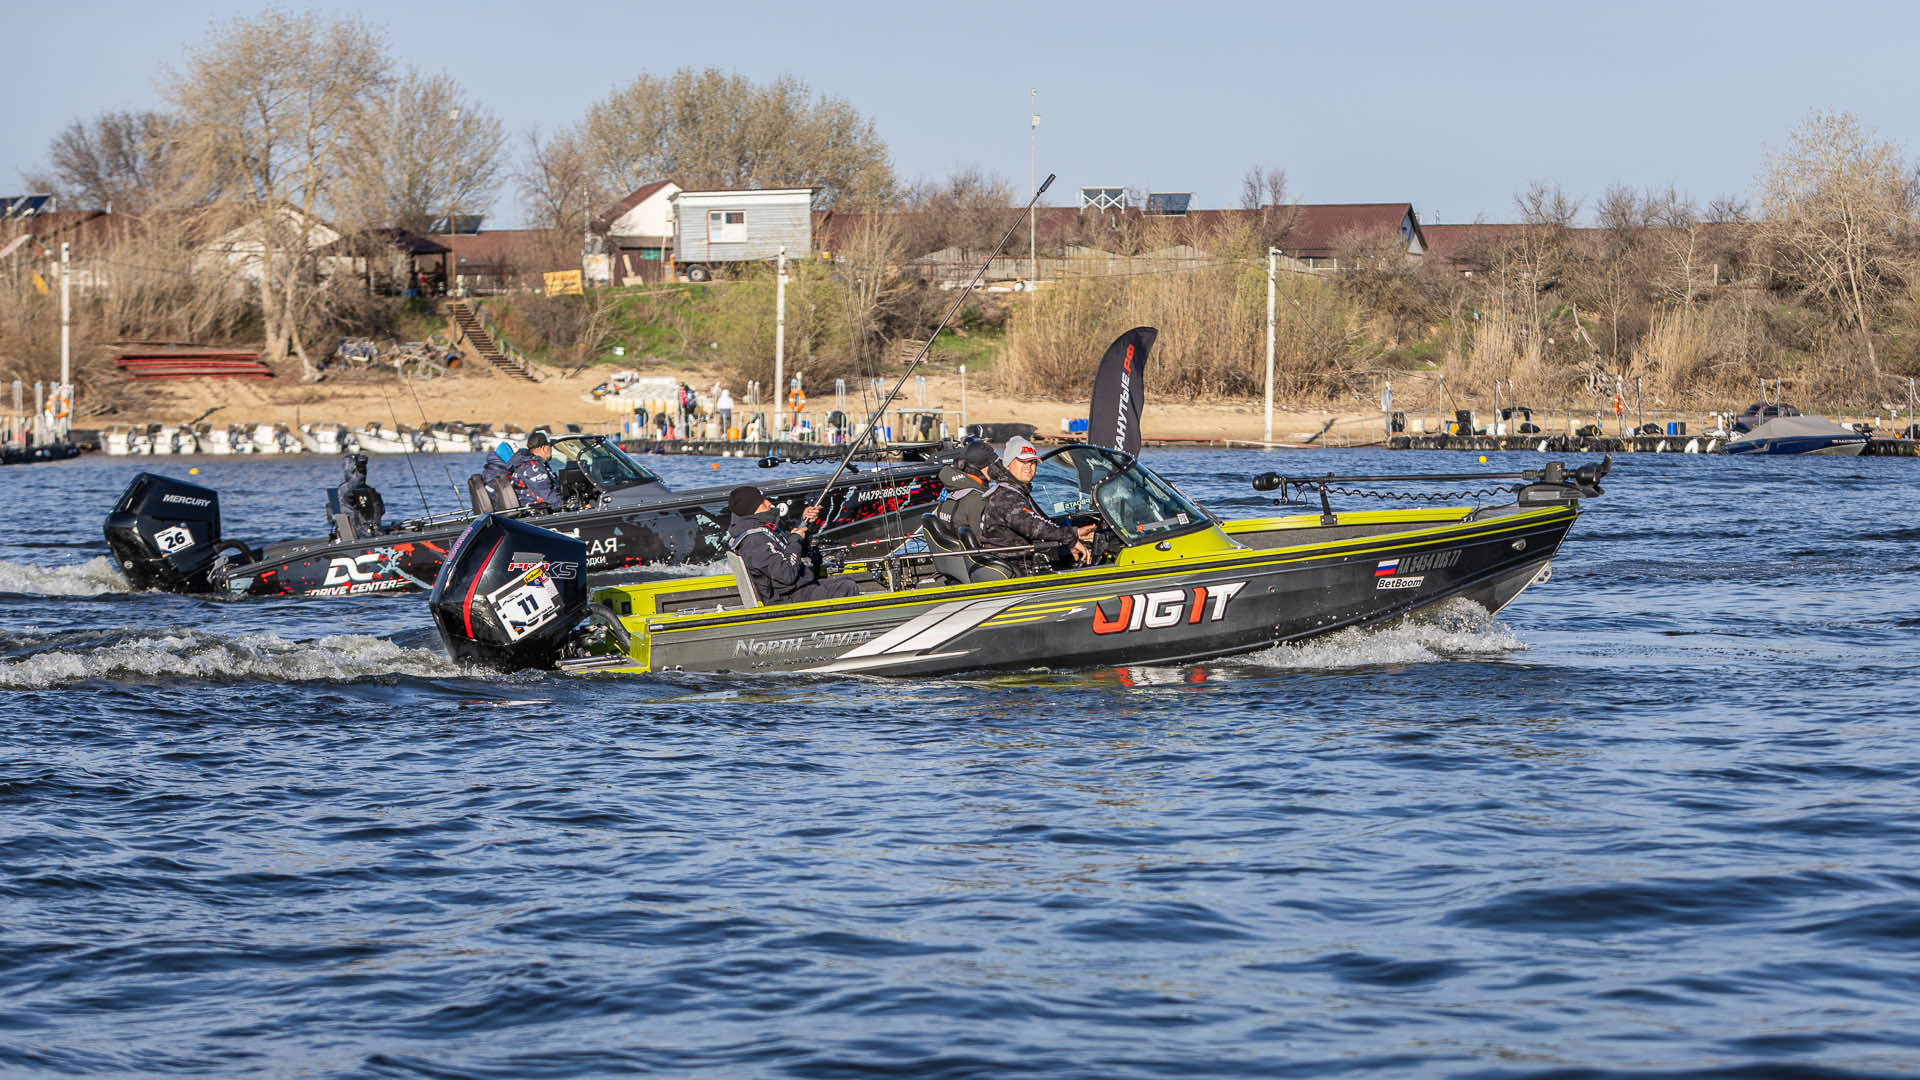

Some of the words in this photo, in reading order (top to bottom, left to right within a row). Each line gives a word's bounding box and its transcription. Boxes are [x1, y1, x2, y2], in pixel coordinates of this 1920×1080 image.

[1114, 343, 1135, 452] АНУТЫЕ.РФ
[162, 494, 211, 507] MERCURY
[165, 531, 186, 549] 26
[310, 585, 349, 596] DRIVE
[349, 579, 397, 593] CENTER
[1378, 579, 1422, 588] BetBoom
[517, 594, 539, 616] 11
